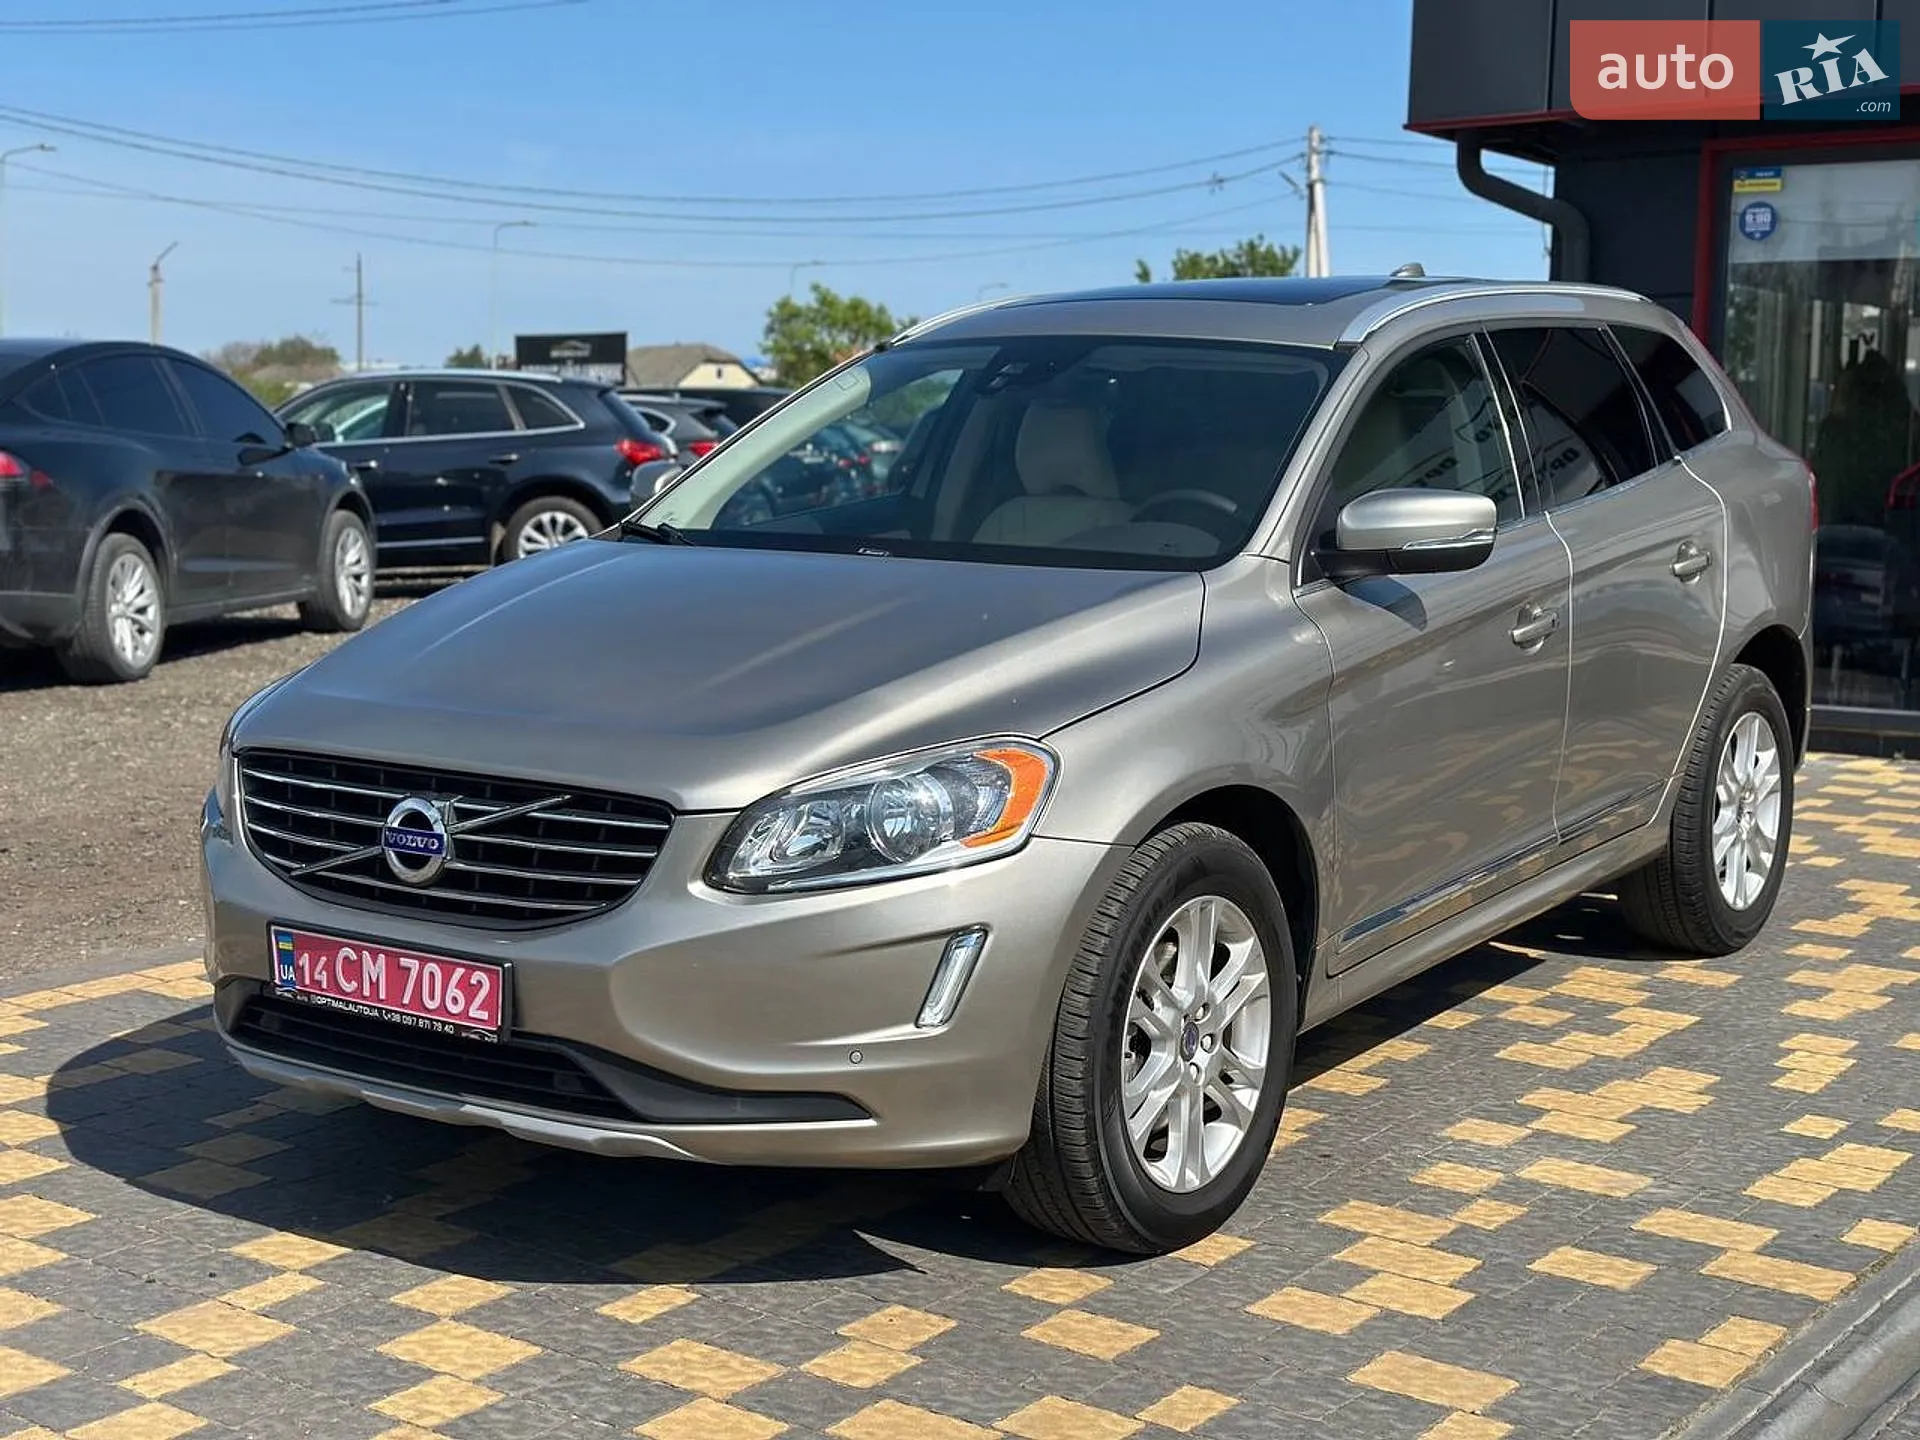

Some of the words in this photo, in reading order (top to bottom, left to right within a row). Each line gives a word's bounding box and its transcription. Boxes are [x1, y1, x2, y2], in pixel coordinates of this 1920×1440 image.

[386, 831, 439, 850] VOLVO
[280, 965, 296, 981] UA
[299, 952, 327, 989] 14
[335, 947, 386, 1000] CM
[399, 957, 490, 1020] 7062
